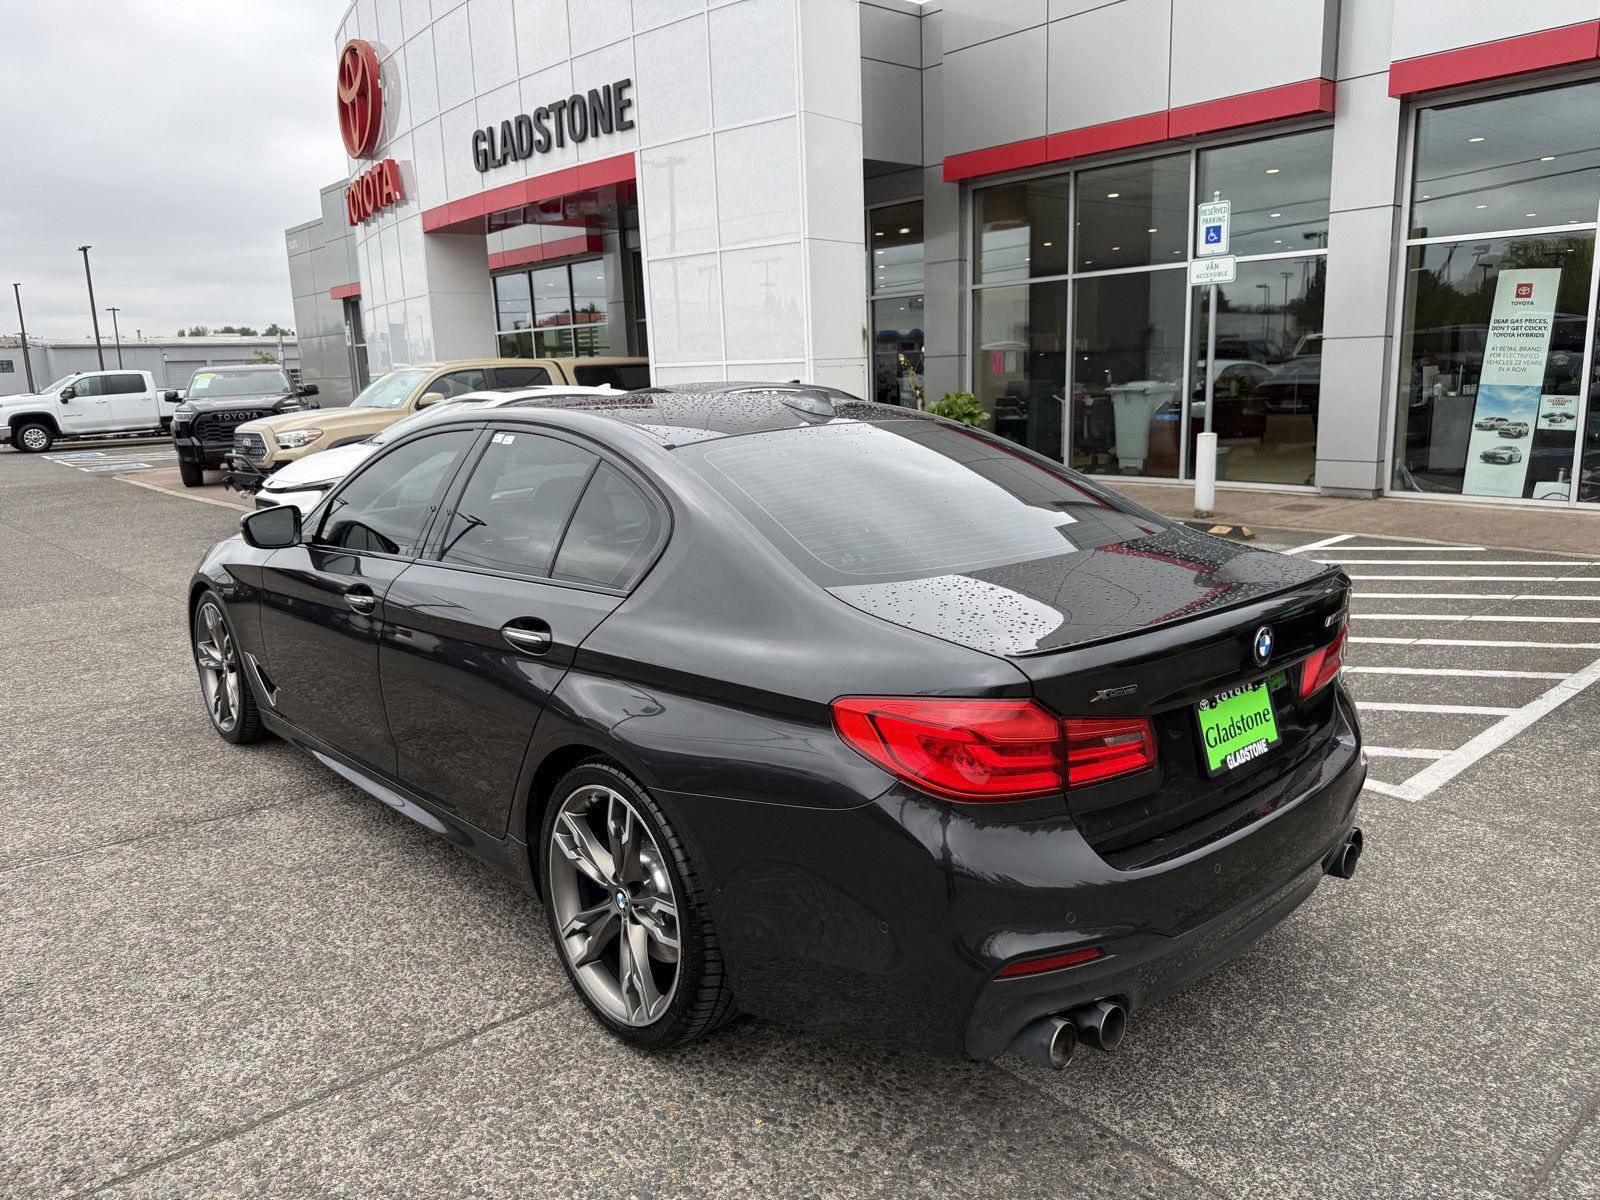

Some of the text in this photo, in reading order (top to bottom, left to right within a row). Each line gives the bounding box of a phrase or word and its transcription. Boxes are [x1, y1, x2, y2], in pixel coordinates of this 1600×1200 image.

[471, 78, 635, 173] GLADSTONE
[343, 158, 403, 227] TOYOTA
[1200, 206, 1227, 216] RESERVED
[1202, 215, 1226, 225] PARKING
[1196, 270, 1228, 279] ACCESSIBLE
[1205, 262, 1219, 271] VAN
[217, 412, 259, 421] TOYOTA
[1214, 682, 1254, 704] TOYOTA
[1205, 707, 1272, 749] Gladstone
[1226, 738, 1269, 770] GLADSTONE
